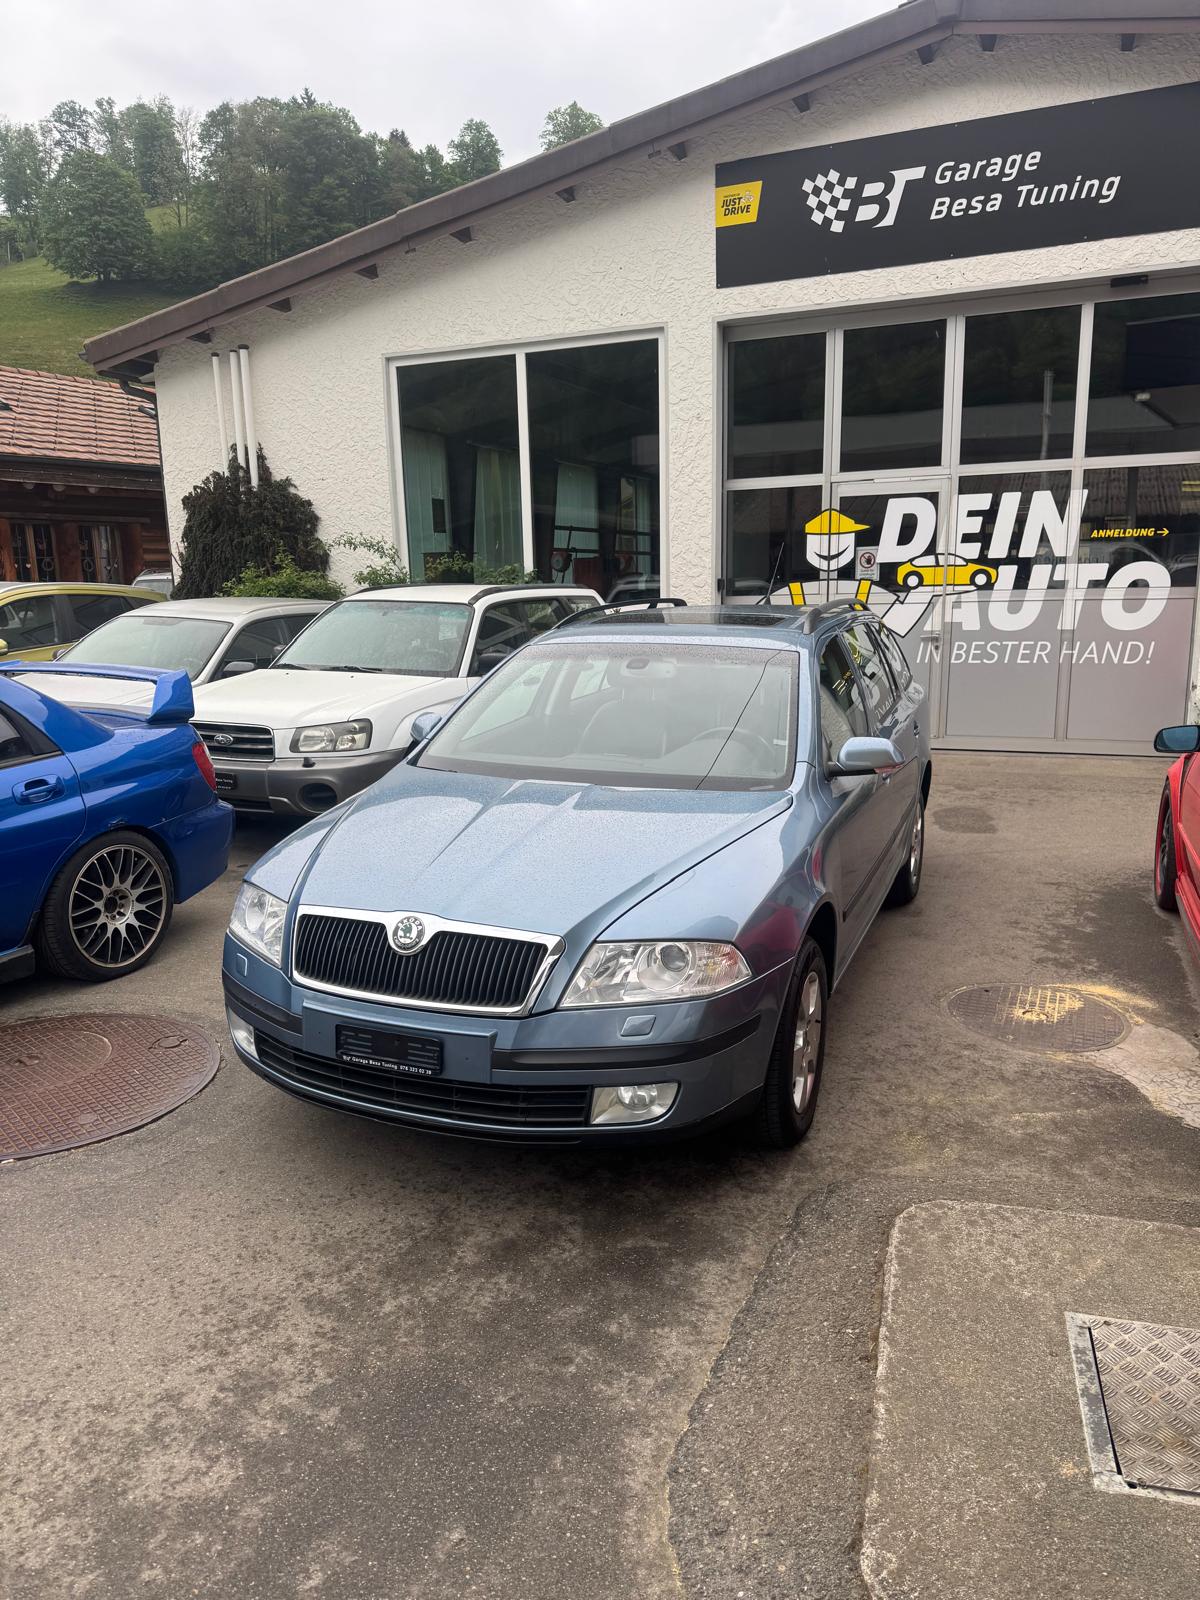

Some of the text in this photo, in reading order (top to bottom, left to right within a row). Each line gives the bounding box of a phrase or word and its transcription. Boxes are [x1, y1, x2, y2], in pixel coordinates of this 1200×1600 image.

[934, 151, 1042, 185] Garage
[721, 196, 743, 208] JUST
[723, 204, 751, 216] DRIVE
[855, 166, 926, 228] BT
[929, 175, 1122, 220] Besa Tuning
[876, 489, 1089, 563] DEIN
[1090, 528, 1155, 538] ANMELDUNG
[922, 561, 1172, 631] AUTO
[916, 641, 1155, 665] IN BESTER HAND!
